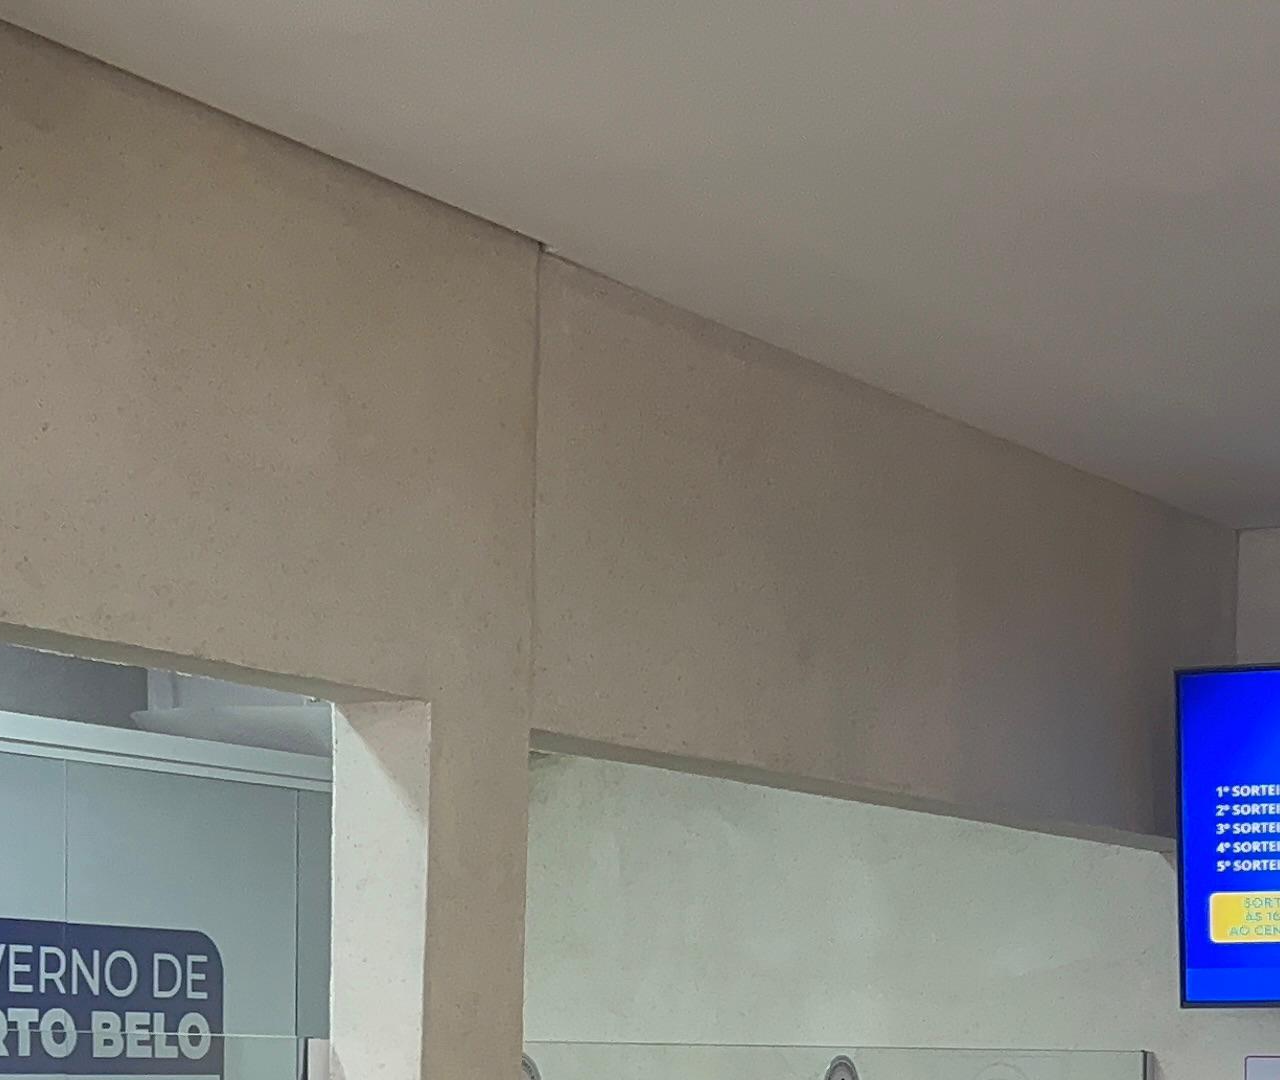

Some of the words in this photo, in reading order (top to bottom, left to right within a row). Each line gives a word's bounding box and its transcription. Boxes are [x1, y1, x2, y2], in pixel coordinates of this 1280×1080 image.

[1229, 925, 1250, 936] AO
[153, 953, 208, 999] DE
[91, 1011, 211, 1060] BELO
